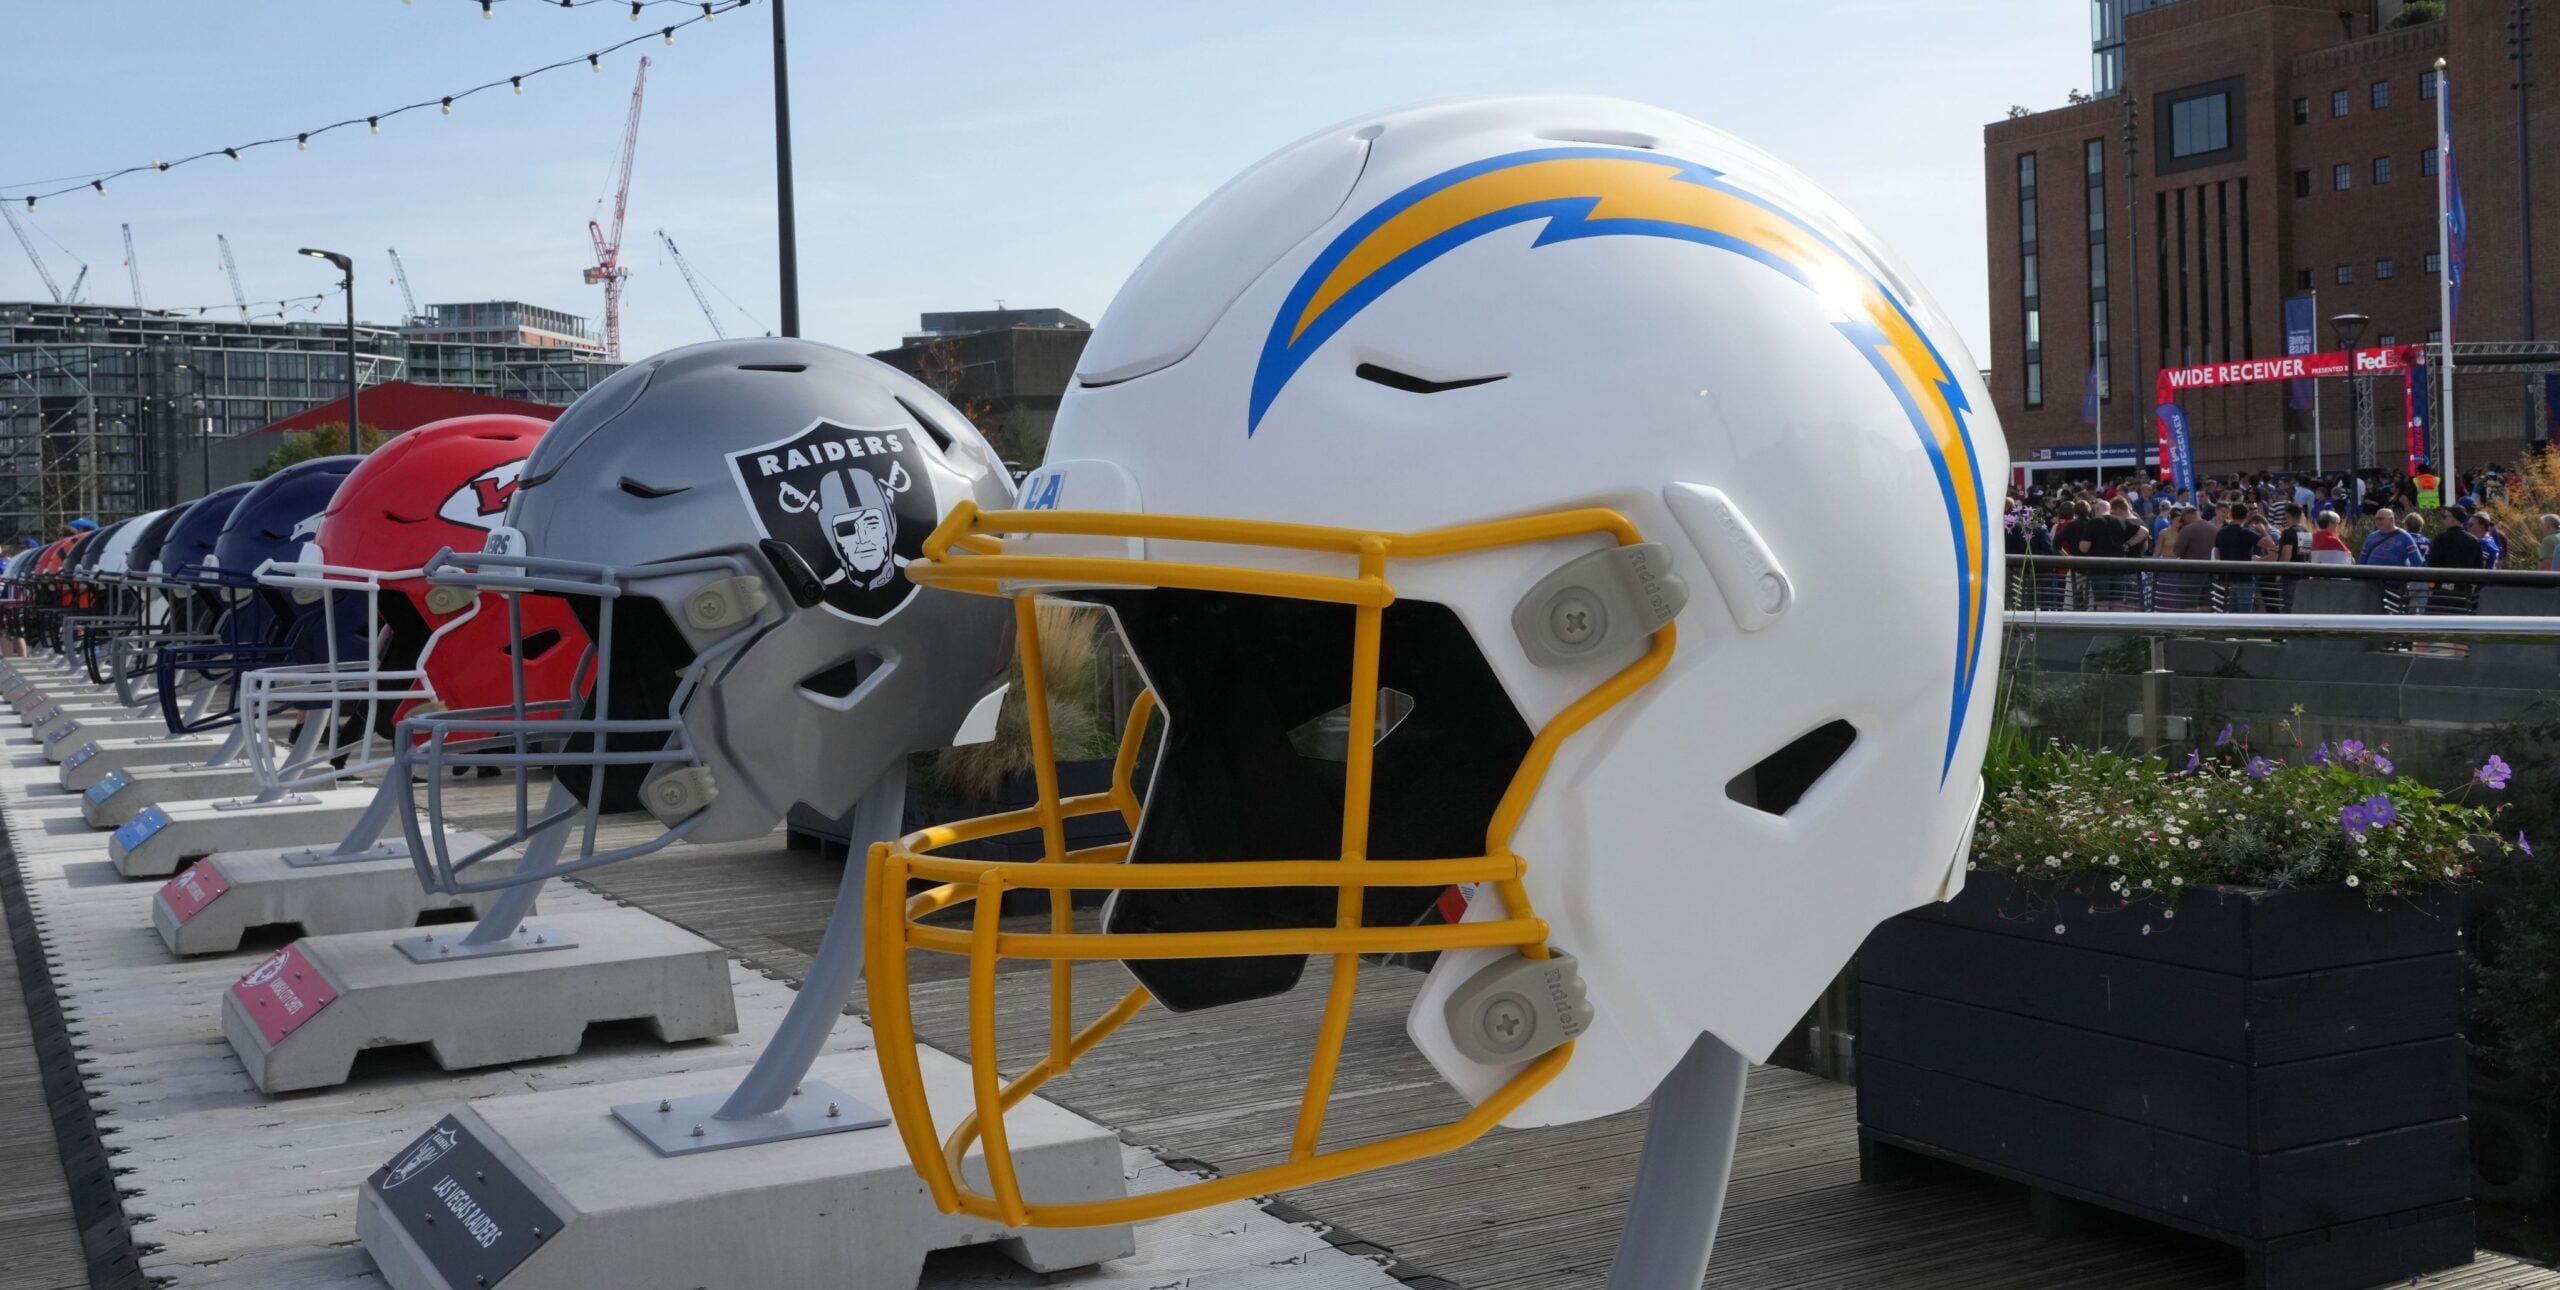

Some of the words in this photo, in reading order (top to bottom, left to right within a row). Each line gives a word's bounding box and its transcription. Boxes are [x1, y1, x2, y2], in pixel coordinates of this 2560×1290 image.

[2168, 368, 2213, 387] WIDE
[2219, 358, 2306, 382] RECEIVER
[2311, 365, 2344, 374] PRESENTED
[756, 434, 904, 477] RAIDERS
[1023, 474, 1061, 510] LA
[1628, 549, 1674, 620] Riddell
[1543, 967, 1580, 1036] Riddell
[432, 1174, 454, 1198] LAS
[443, 1183, 477, 1220] VEGAS
[462, 1207, 503, 1249] RAIDERS
